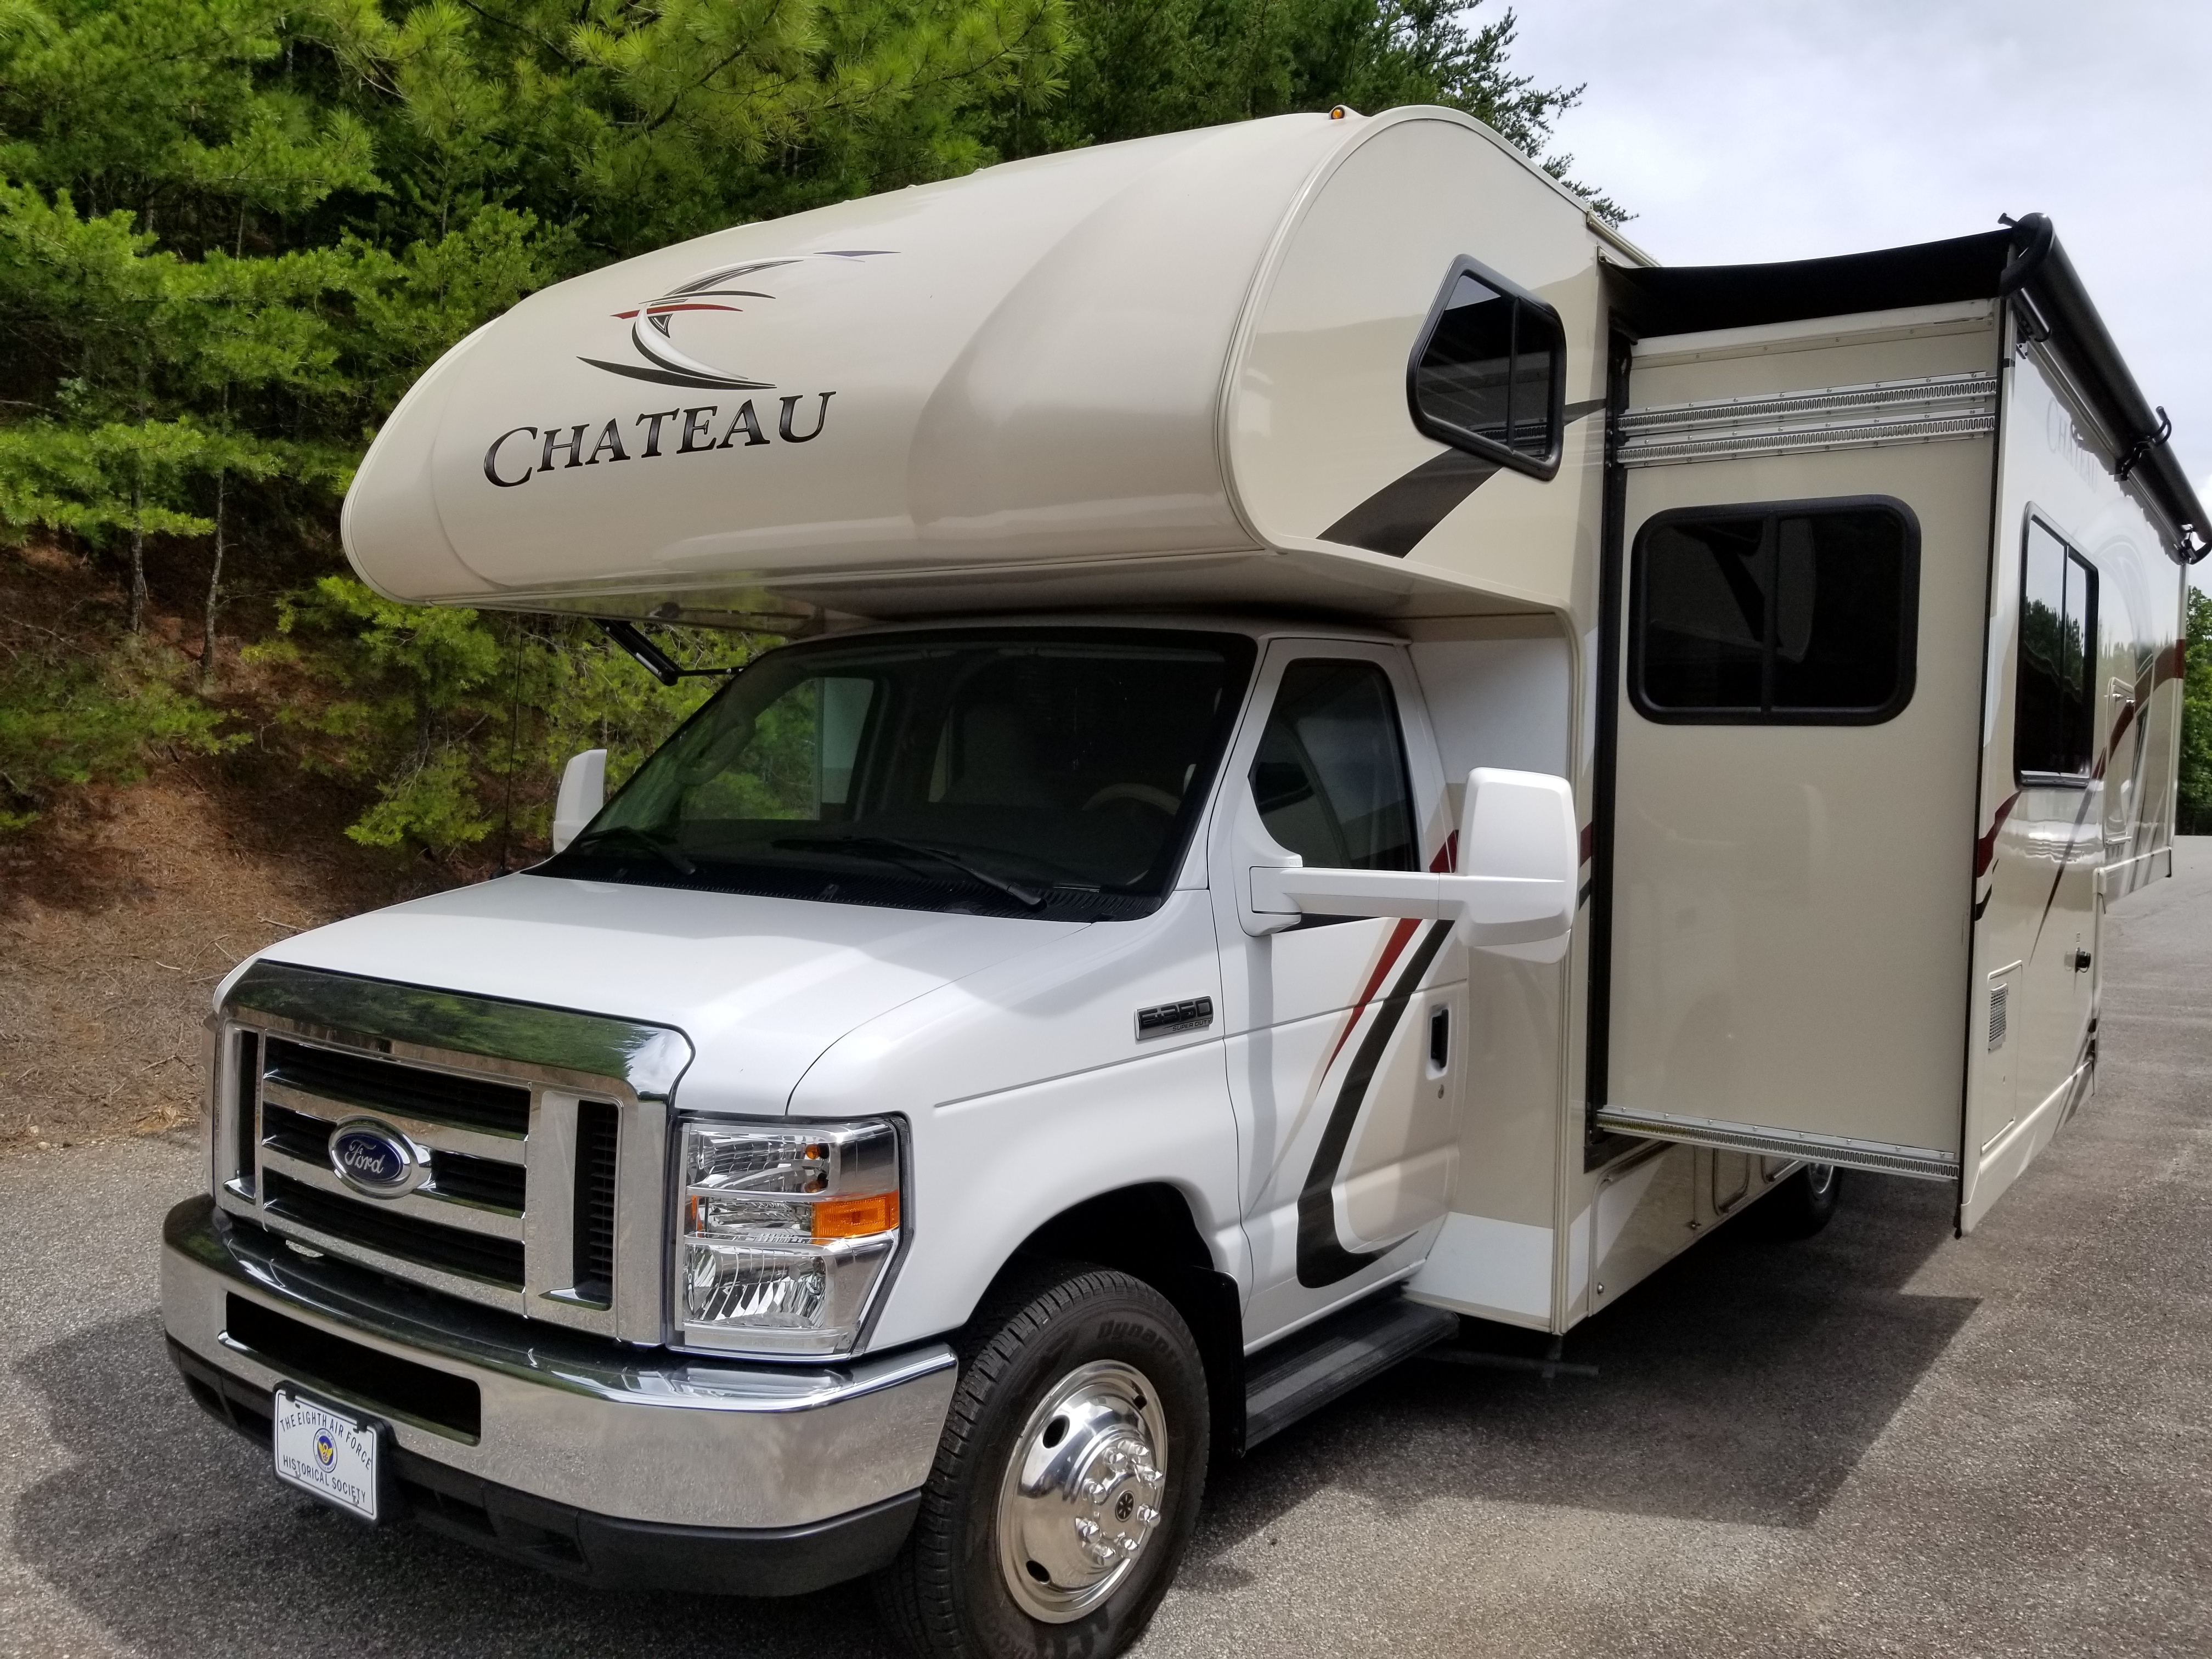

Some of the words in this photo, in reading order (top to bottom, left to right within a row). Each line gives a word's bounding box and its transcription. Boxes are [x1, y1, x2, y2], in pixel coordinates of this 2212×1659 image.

[483, 391, 836, 488] CHATEAU
[1172, 1023, 1193, 1031] SUPER
[345, 1139, 386, 1173] Ford
[280, 1414, 296, 1432] THE
[298, 1411, 327, 1427] EIGHTH
[330, 1418, 344, 1438] AIR
[346, 1432, 372, 1470] FORCE
[283, 1454, 330, 1486] HISTORICAL
[332, 1477, 366, 1503] SOCIETY
